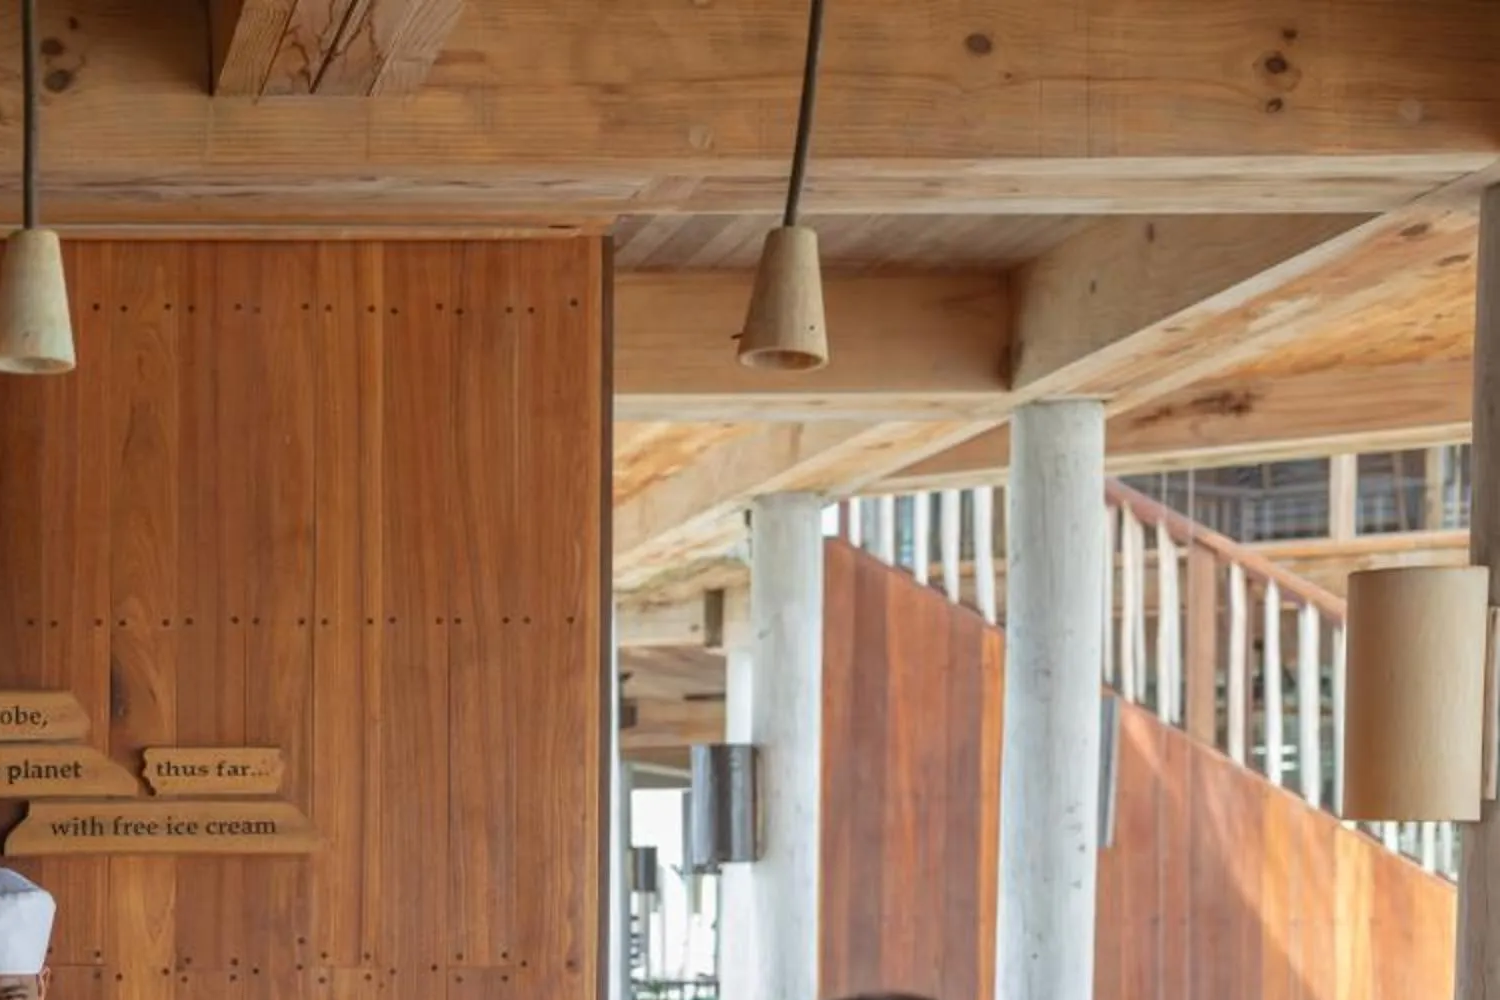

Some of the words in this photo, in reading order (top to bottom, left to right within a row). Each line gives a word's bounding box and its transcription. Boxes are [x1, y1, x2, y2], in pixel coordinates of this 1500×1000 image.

[6, 759, 83, 785] planet
[157, 760, 209, 777] thus
[50, 815, 104, 837] with
[113, 815, 159, 837] free
[166, 815, 199, 836] ice
[205, 819, 277, 836] cream
